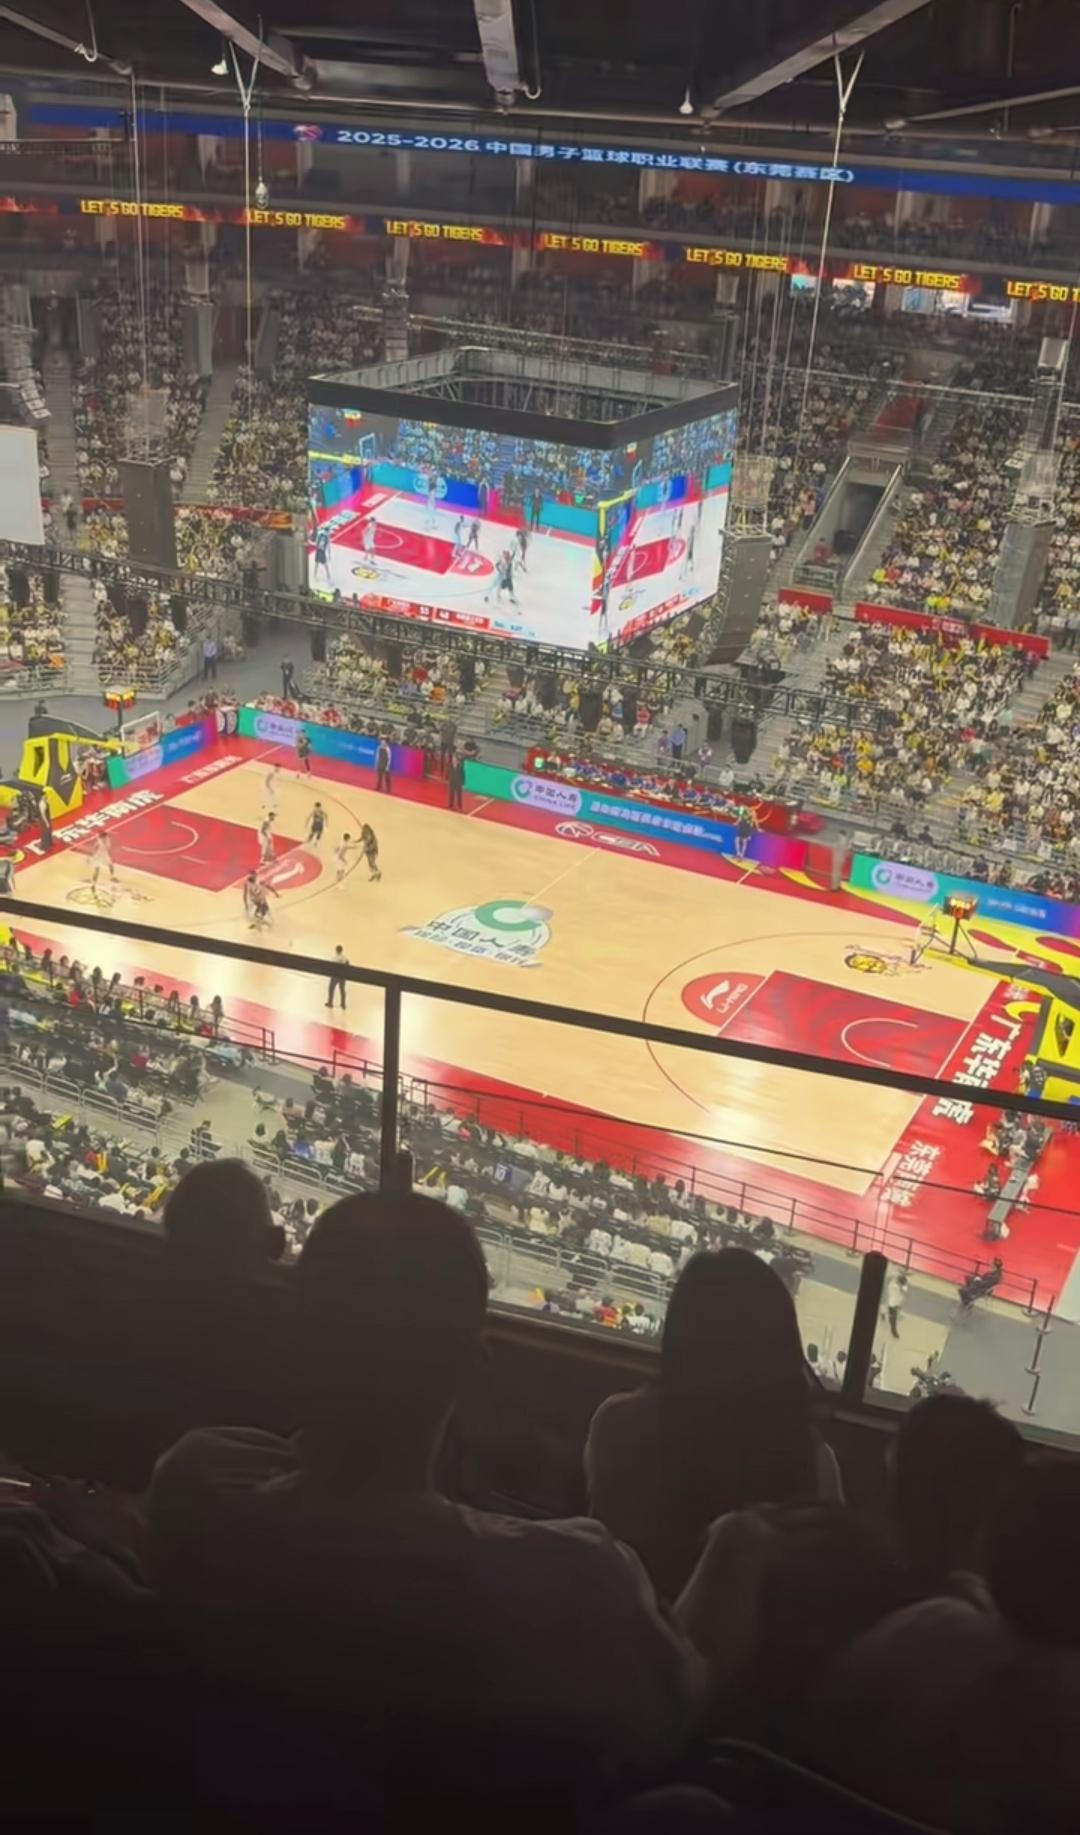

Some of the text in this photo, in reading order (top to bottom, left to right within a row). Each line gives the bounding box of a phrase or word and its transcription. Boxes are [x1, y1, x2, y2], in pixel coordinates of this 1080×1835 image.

[337, 130, 480, 151] 2025-2026
[121, 202, 138, 215] GO
[141, 203, 184, 218] TIGERS
[286, 212, 302, 226] GO
[304, 213, 346, 229] TIGERS
[424, 224, 440, 237] GO
[442, 225, 483, 241] TIGERS
[583, 238, 599, 251] GO
[603, 240, 643, 257] TIGERS
[725, 251, 742, 266] GO
[745, 254, 787, 271] TIGERS
[895, 269, 911, 284] GO
[916, 271, 960, 289] TIGERS
[1050, 285, 1068, 301] GO
